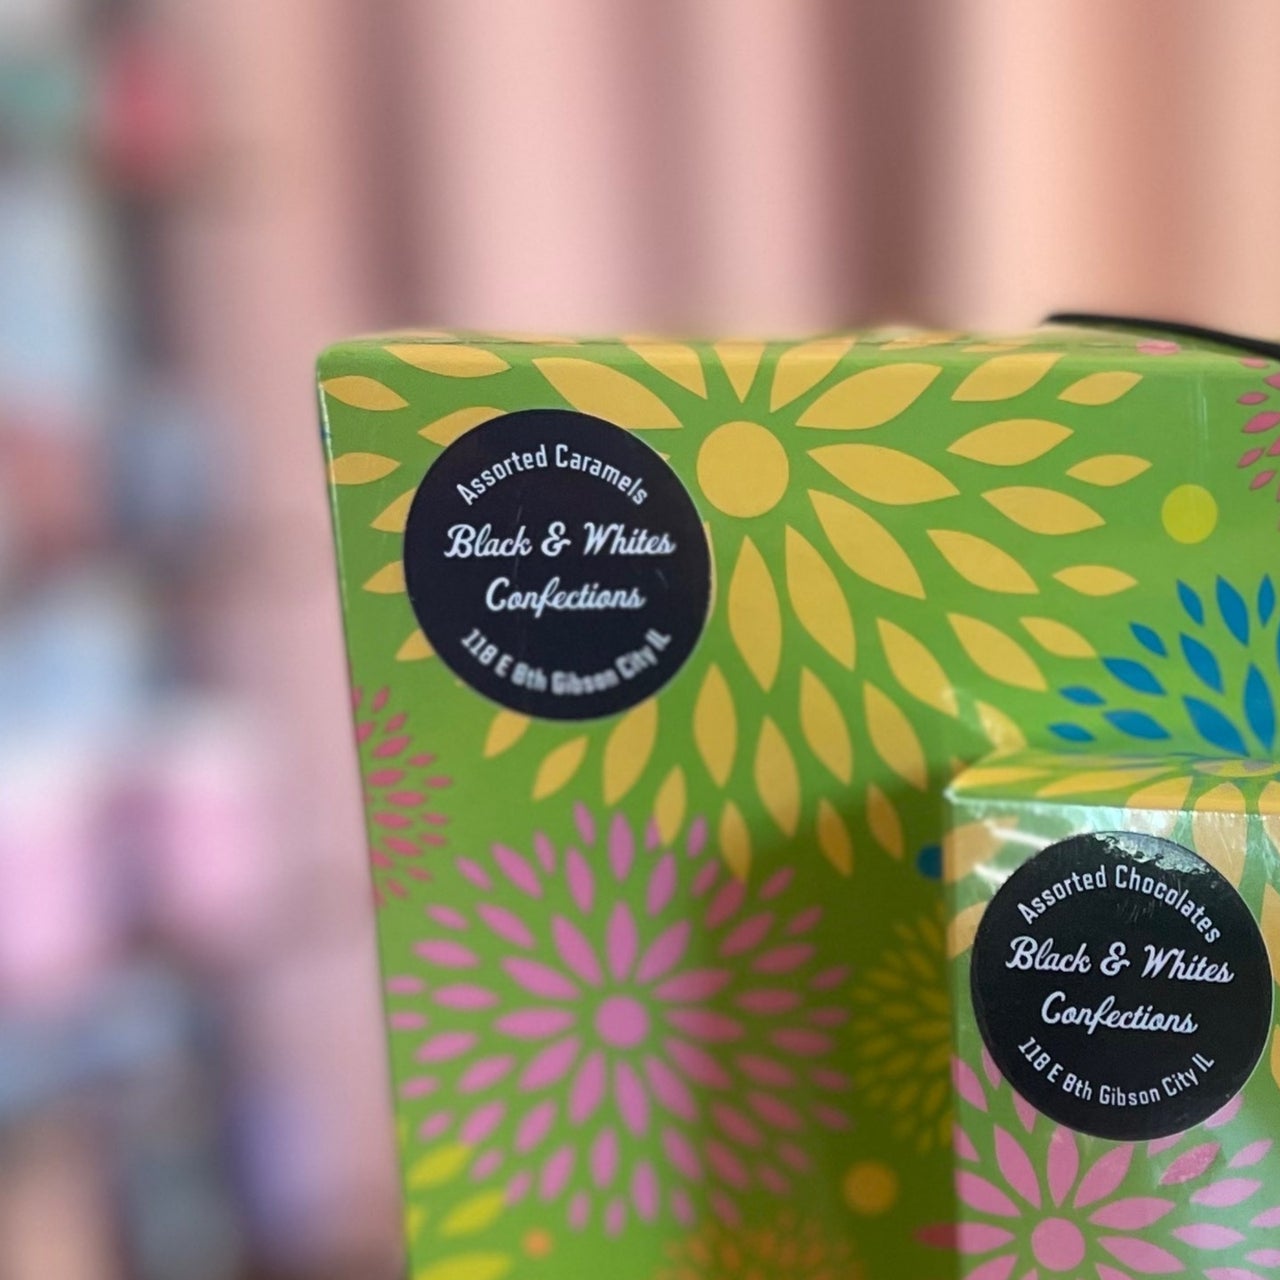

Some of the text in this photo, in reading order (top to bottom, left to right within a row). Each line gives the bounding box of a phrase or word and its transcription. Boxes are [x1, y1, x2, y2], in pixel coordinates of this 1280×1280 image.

[456, 444, 648, 505] Assorted Caramels
[444, 521, 676, 558] Black & Whites
[486, 577, 646, 618] Confections
[461, 629, 497, 665] 118
[494, 655, 513, 677] E
[511, 663, 547, 691] 8th
[551, 669, 619, 695] Gibson
[615, 648, 658, 679] City
[1017, 865, 1220, 943] Assorted Chocolates
[1005, 936, 1234, 983] Black & Whites
[1041, 991, 1199, 1035] Confections
[1018, 1037, 1215, 1106] 118 E 8th Gibson City IL
